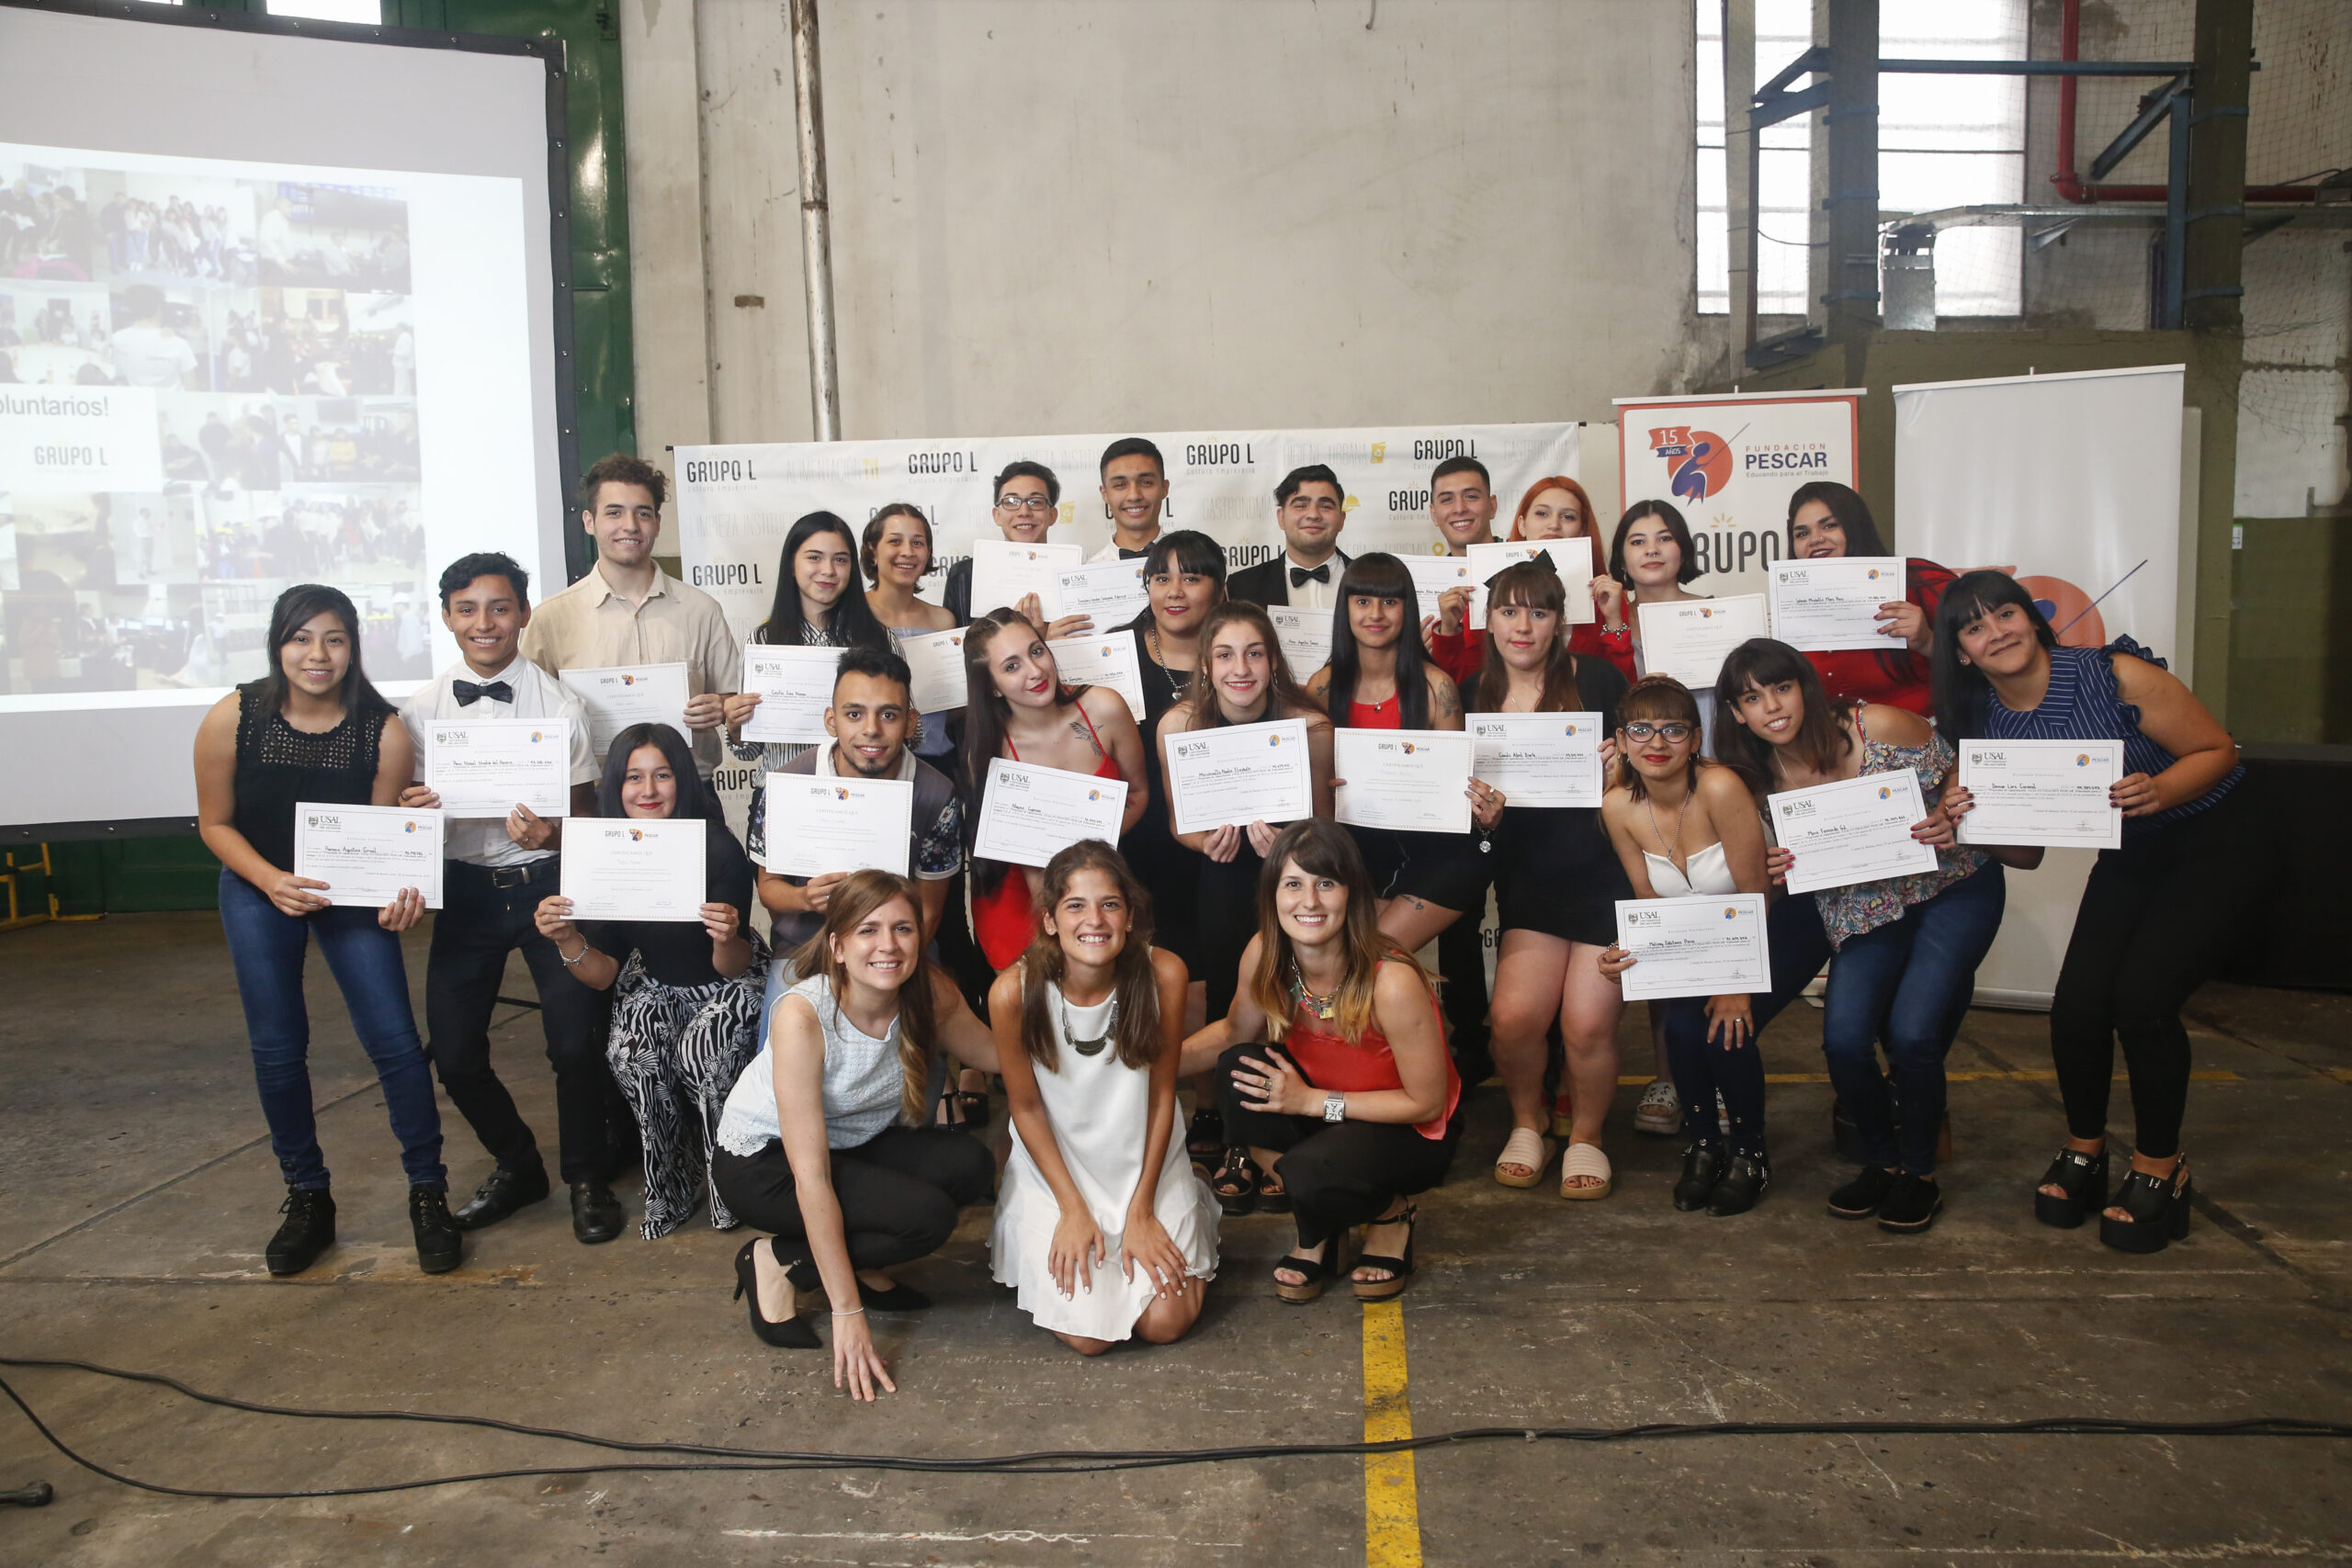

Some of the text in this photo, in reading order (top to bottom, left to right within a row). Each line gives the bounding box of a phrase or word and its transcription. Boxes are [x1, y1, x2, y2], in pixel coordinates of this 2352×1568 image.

[1659, 429, 1679, 445] 15
[1186, 443, 1255, 466] GRUPO L
[1414, 439, 1477, 460] GRUPO L
[1666, 447, 1681, 456] AÑOS
[1746, 443, 1826, 453] FUNDACION
[34, 446, 108, 466] GRUPO L
[1745, 452, 1827, 469] PESCAR
[908, 451, 978, 475] GRUPO L
[686, 459, 757, 482] GRUPO L
[1780, 471, 1794, 479] para
[1804, 469, 1828, 478] Trabajo
[1166, 497, 1173, 517] L
[1389, 491, 1430, 512] GRUP
[931, 504, 939, 525] L
[1693, 530, 1780, 574] RUPO
[693, 563, 763, 586] GRUPO L
[1070, 574, 1088, 582] USAL
[1790, 570, 1809, 579] USAL
[1487, 724, 1507, 732] USAL
[1189, 742, 1210, 751] USAL
[1984, 751, 2007, 761] USAL
[1012, 773, 1031, 784] USAL
[1792, 799, 1815, 810] USAL
[320, 816, 342, 824] USAL
[1639, 911, 1661, 919] USAL
